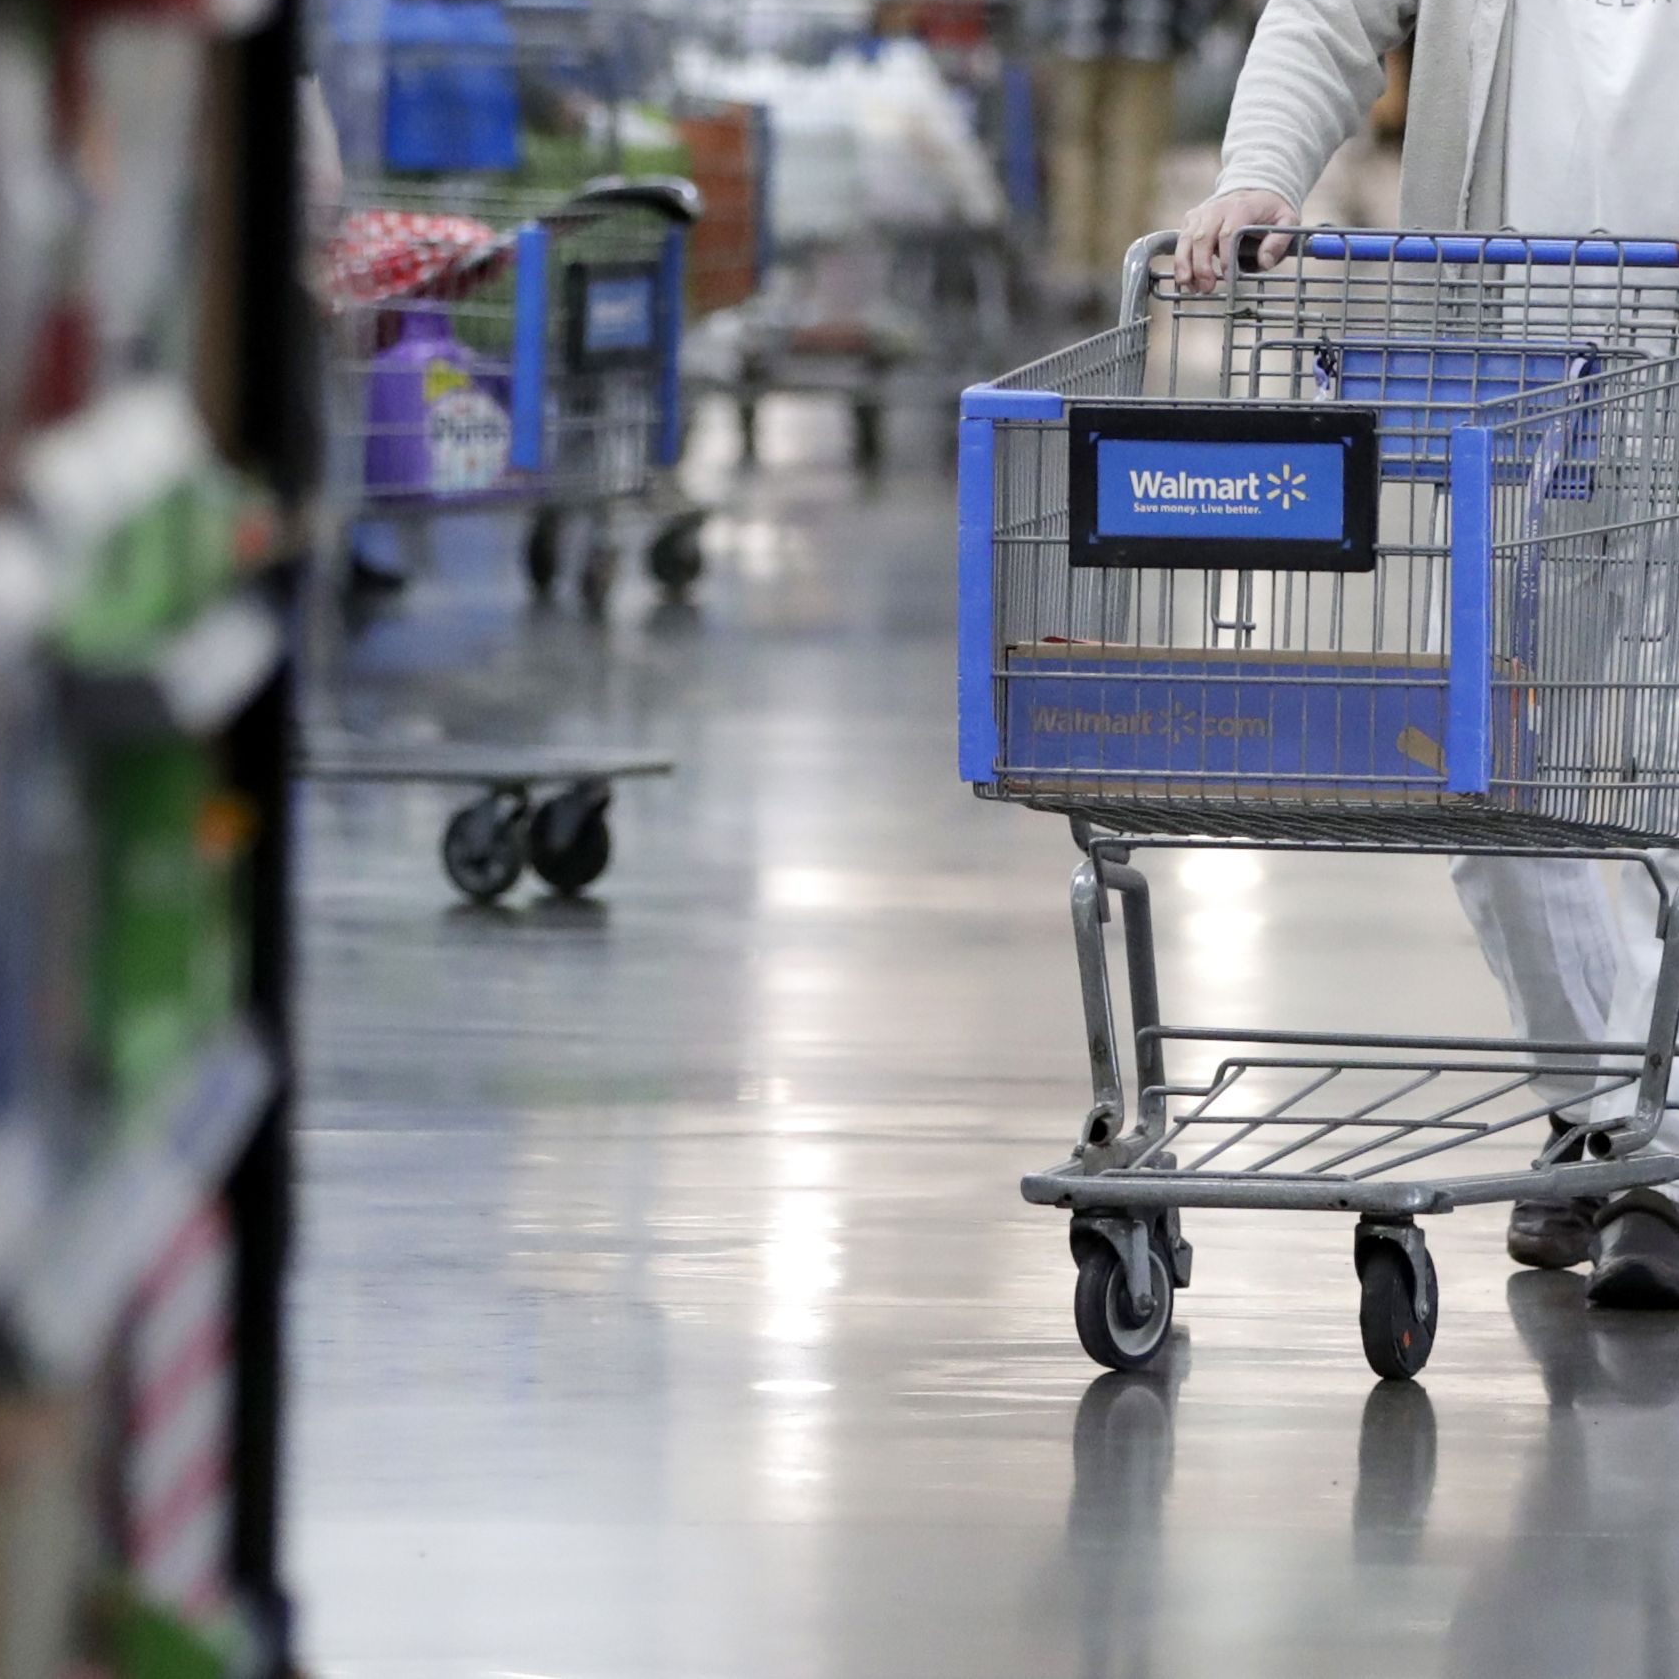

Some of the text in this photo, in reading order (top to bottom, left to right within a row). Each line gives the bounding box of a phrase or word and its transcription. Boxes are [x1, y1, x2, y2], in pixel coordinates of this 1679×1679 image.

[1129, 470, 1260, 502] Walmart
[1133, 502, 1261, 515] Save money. Live better.
[1031, 705, 1153, 735] Walmart
